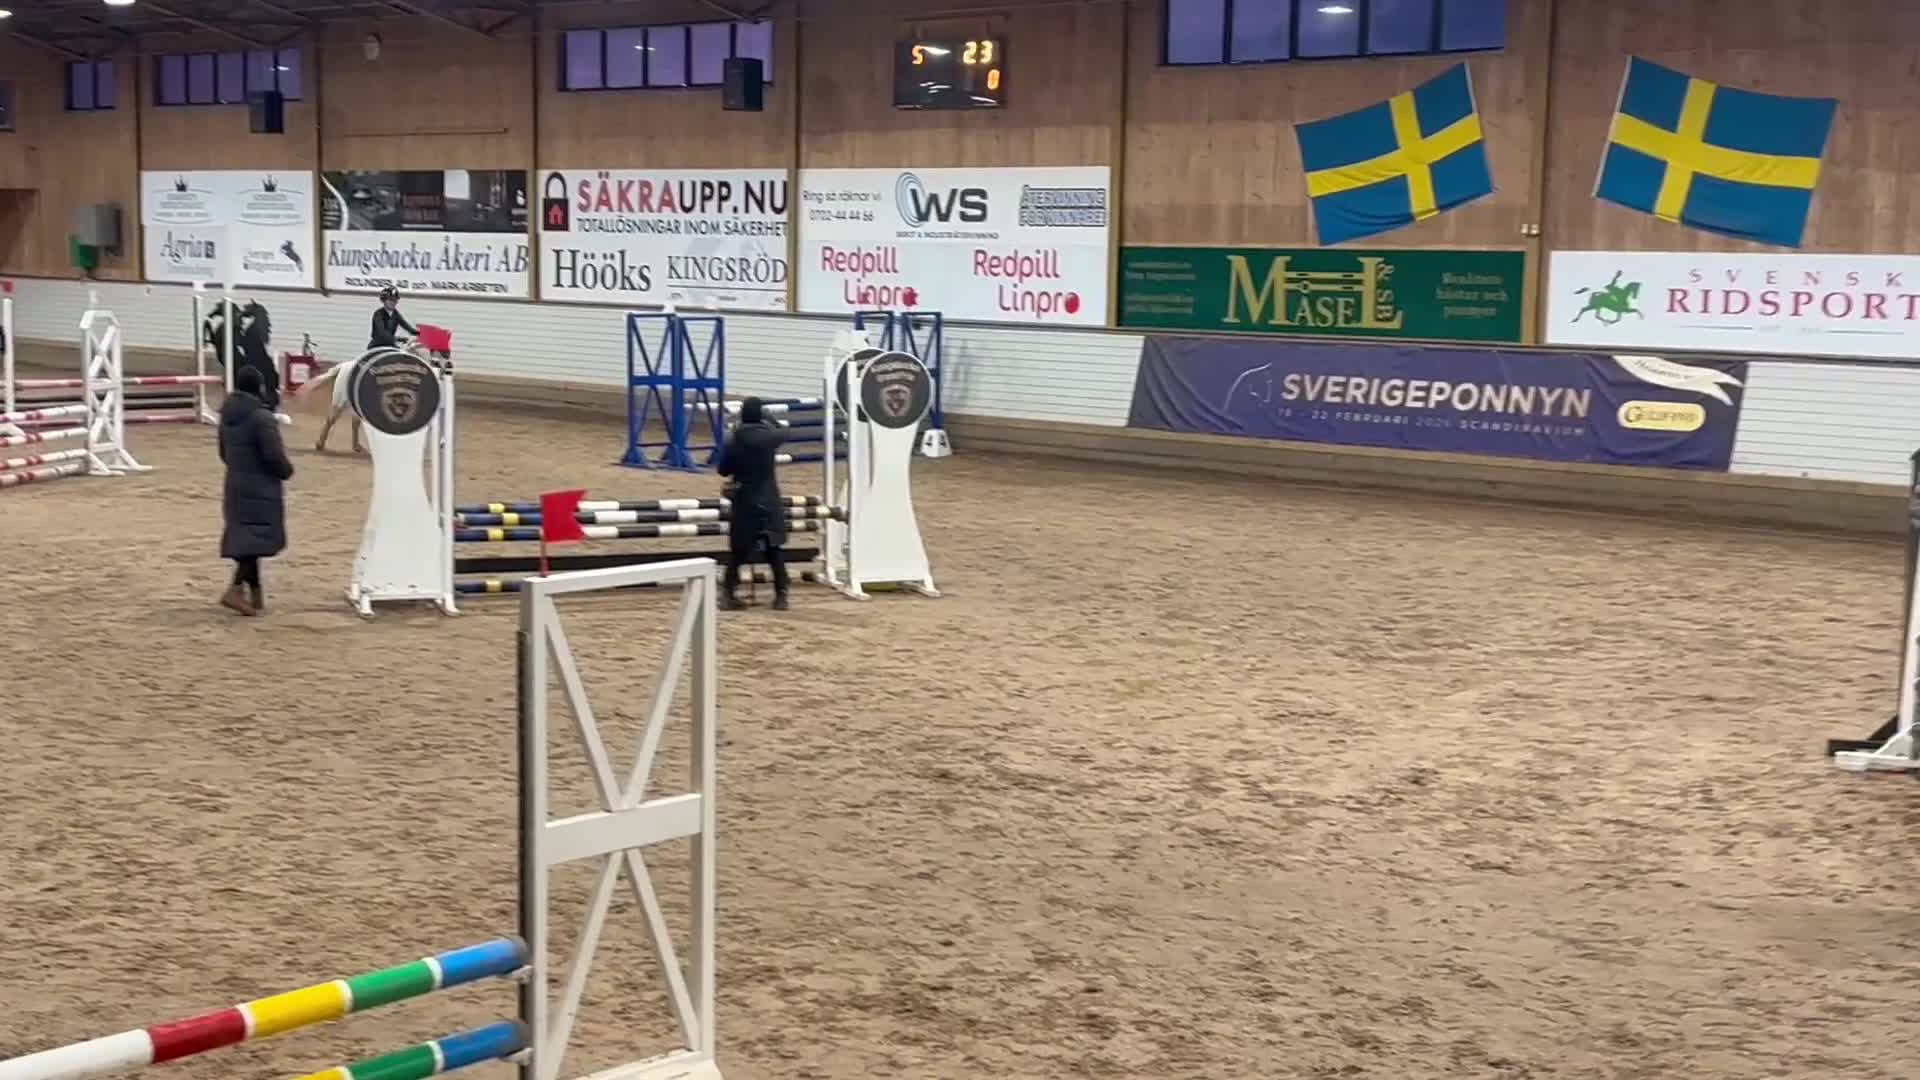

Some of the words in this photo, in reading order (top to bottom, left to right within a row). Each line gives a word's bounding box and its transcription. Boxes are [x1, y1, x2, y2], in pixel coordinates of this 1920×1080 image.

[963, 40, 993, 64] 23
[577, 171, 788, 215] SÄKRAUPP.NU
[577, 216, 681, 234] TOTALLÖSNINGAR
[685, 219, 720, 235] INOM
[724, 217, 788, 236] SÄKERHET
[328, 240, 431, 275] Kungsbacka
[436, 235, 492, 272] Åkeri
[495, 244, 529, 272] AB
[552, 248, 652, 292] Hööks
[666, 253, 788, 283] KINGSRÖD
[821, 246, 899, 278] Redpill
[973, 249, 1061, 283] Redpill
[1666, 288, 1920, 321] RIDSPORT
[1282, 373, 1591, 421] SVERIGEPONNYN
